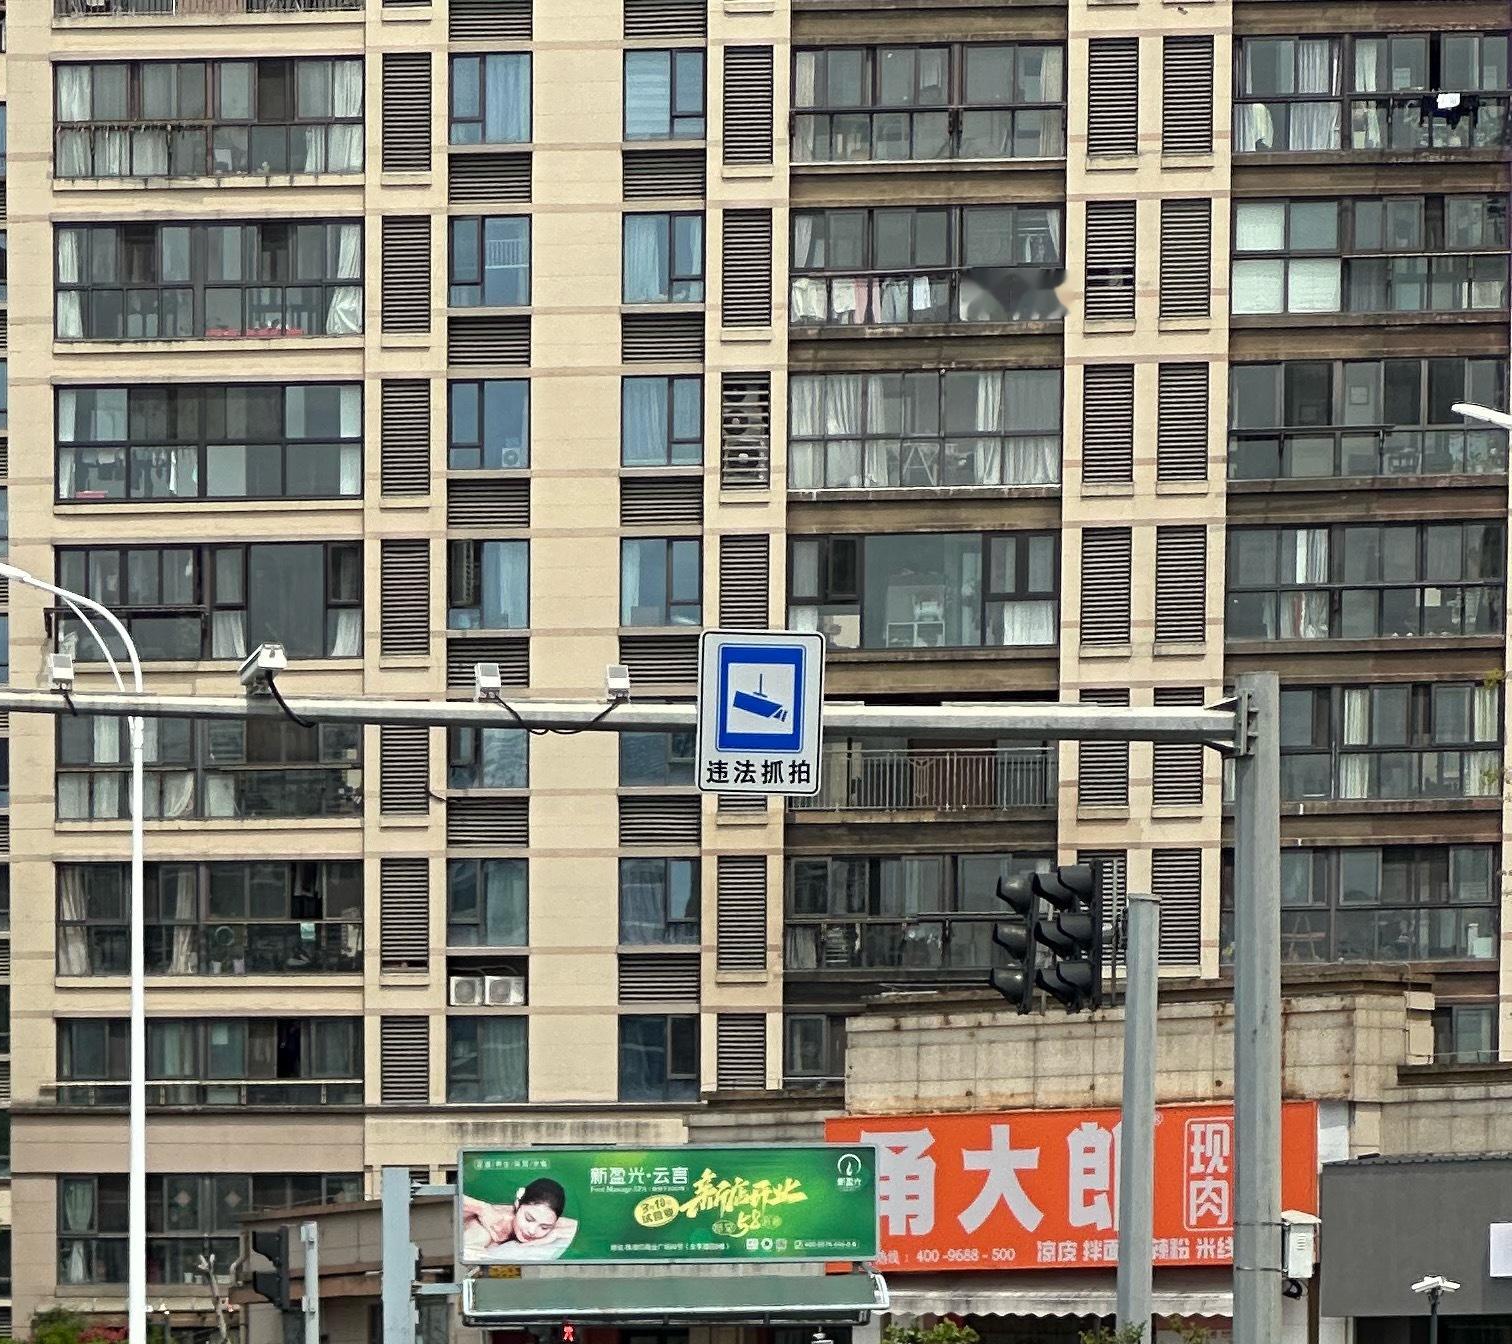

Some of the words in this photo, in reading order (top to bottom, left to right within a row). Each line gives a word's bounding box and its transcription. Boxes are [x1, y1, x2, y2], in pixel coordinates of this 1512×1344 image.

[706, 759, 812, 784] 违法抓拍
[1190, 1123, 1231, 1225] 现肉
[1152, 1237, 1190, 1261] 辣粉
